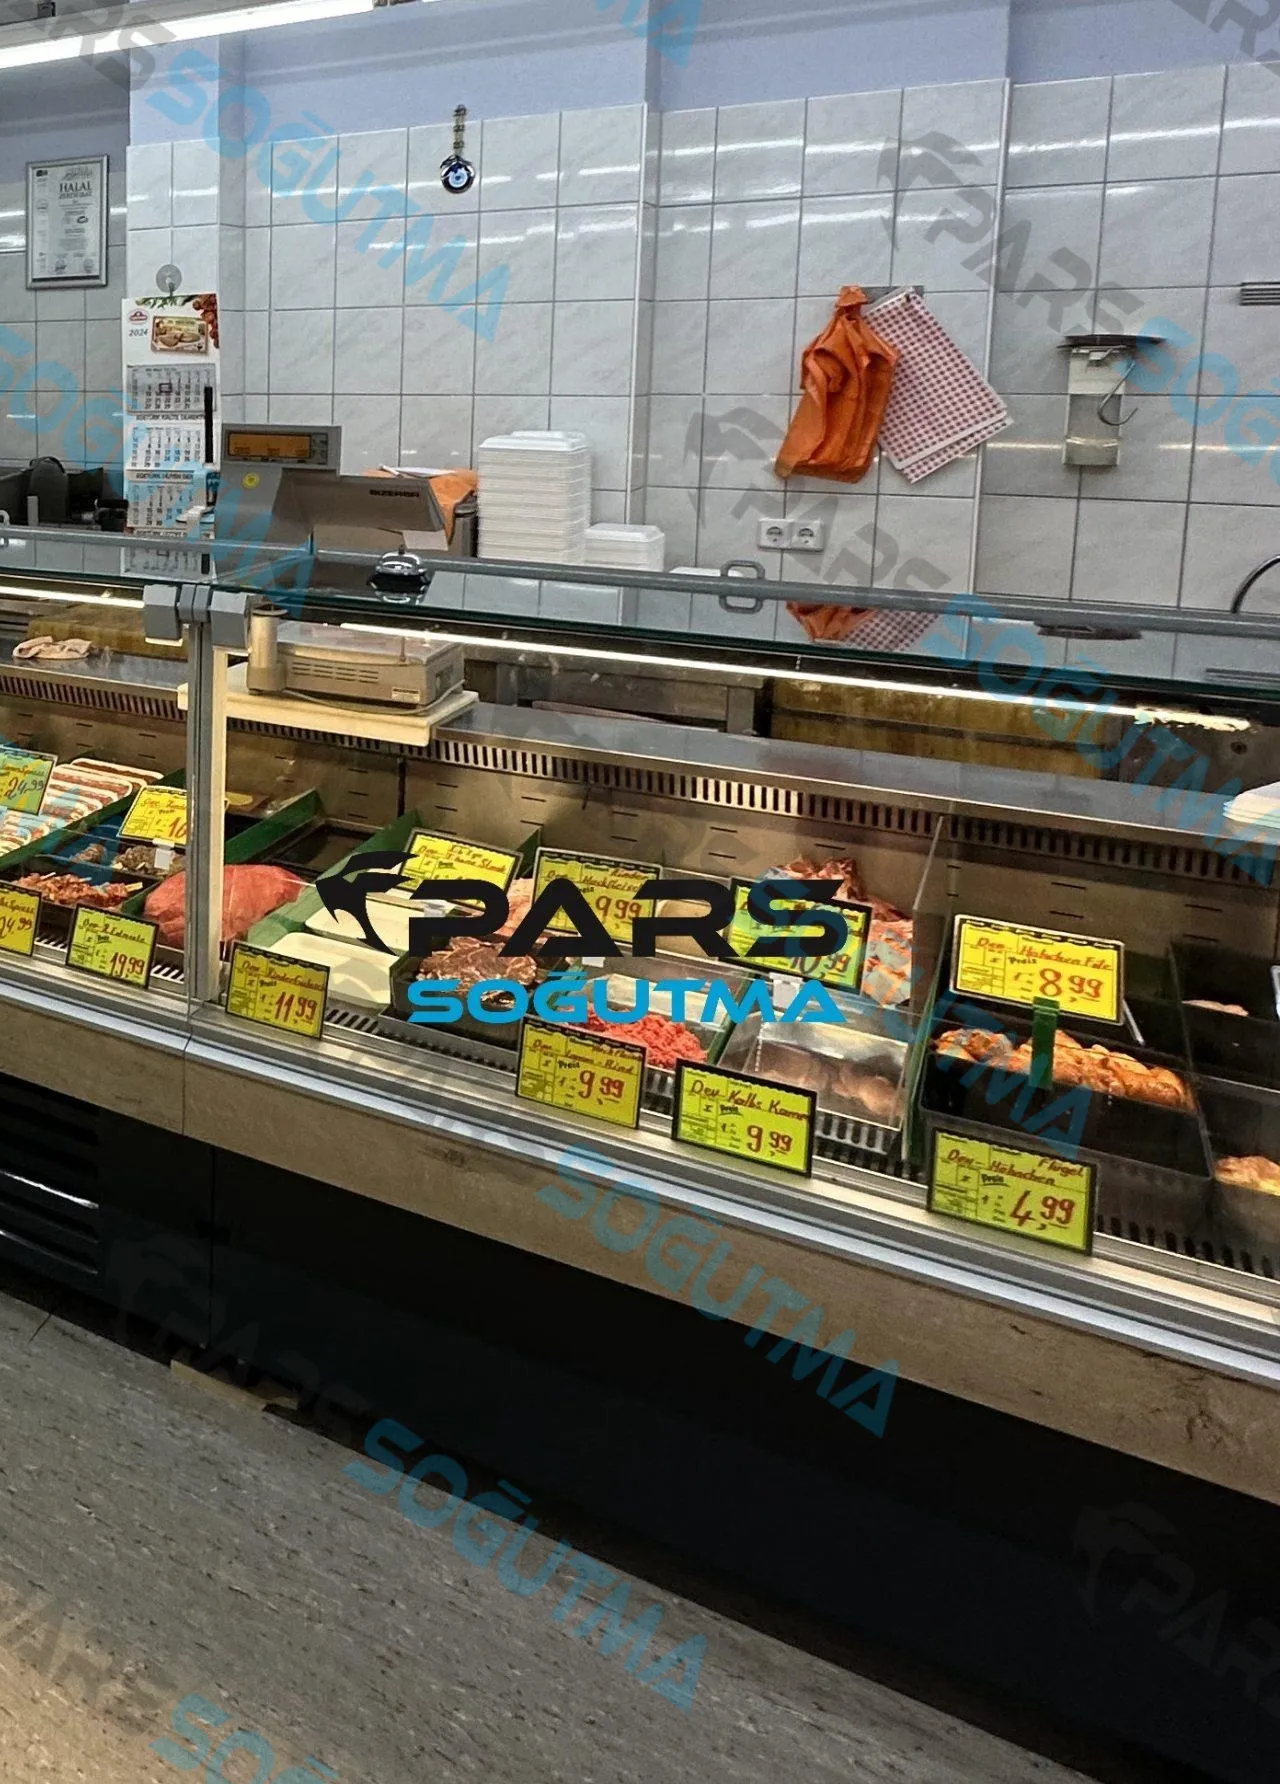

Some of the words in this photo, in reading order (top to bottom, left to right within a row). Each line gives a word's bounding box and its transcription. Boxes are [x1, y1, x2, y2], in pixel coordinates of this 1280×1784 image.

[59, 181, 92, 192] HALAL
[595, 894, 642, 930] 9,99
[1007, 956, 1037, 965] Preis
[1038, 967, 1104, 1003] 8,99
[274, 991, 318, 1025] 11,99
[578, 1069, 626, 1106] 9,99
[746, 1124, 794, 1157] 9,99
[1009, 1189, 1077, 1232] 4,99
